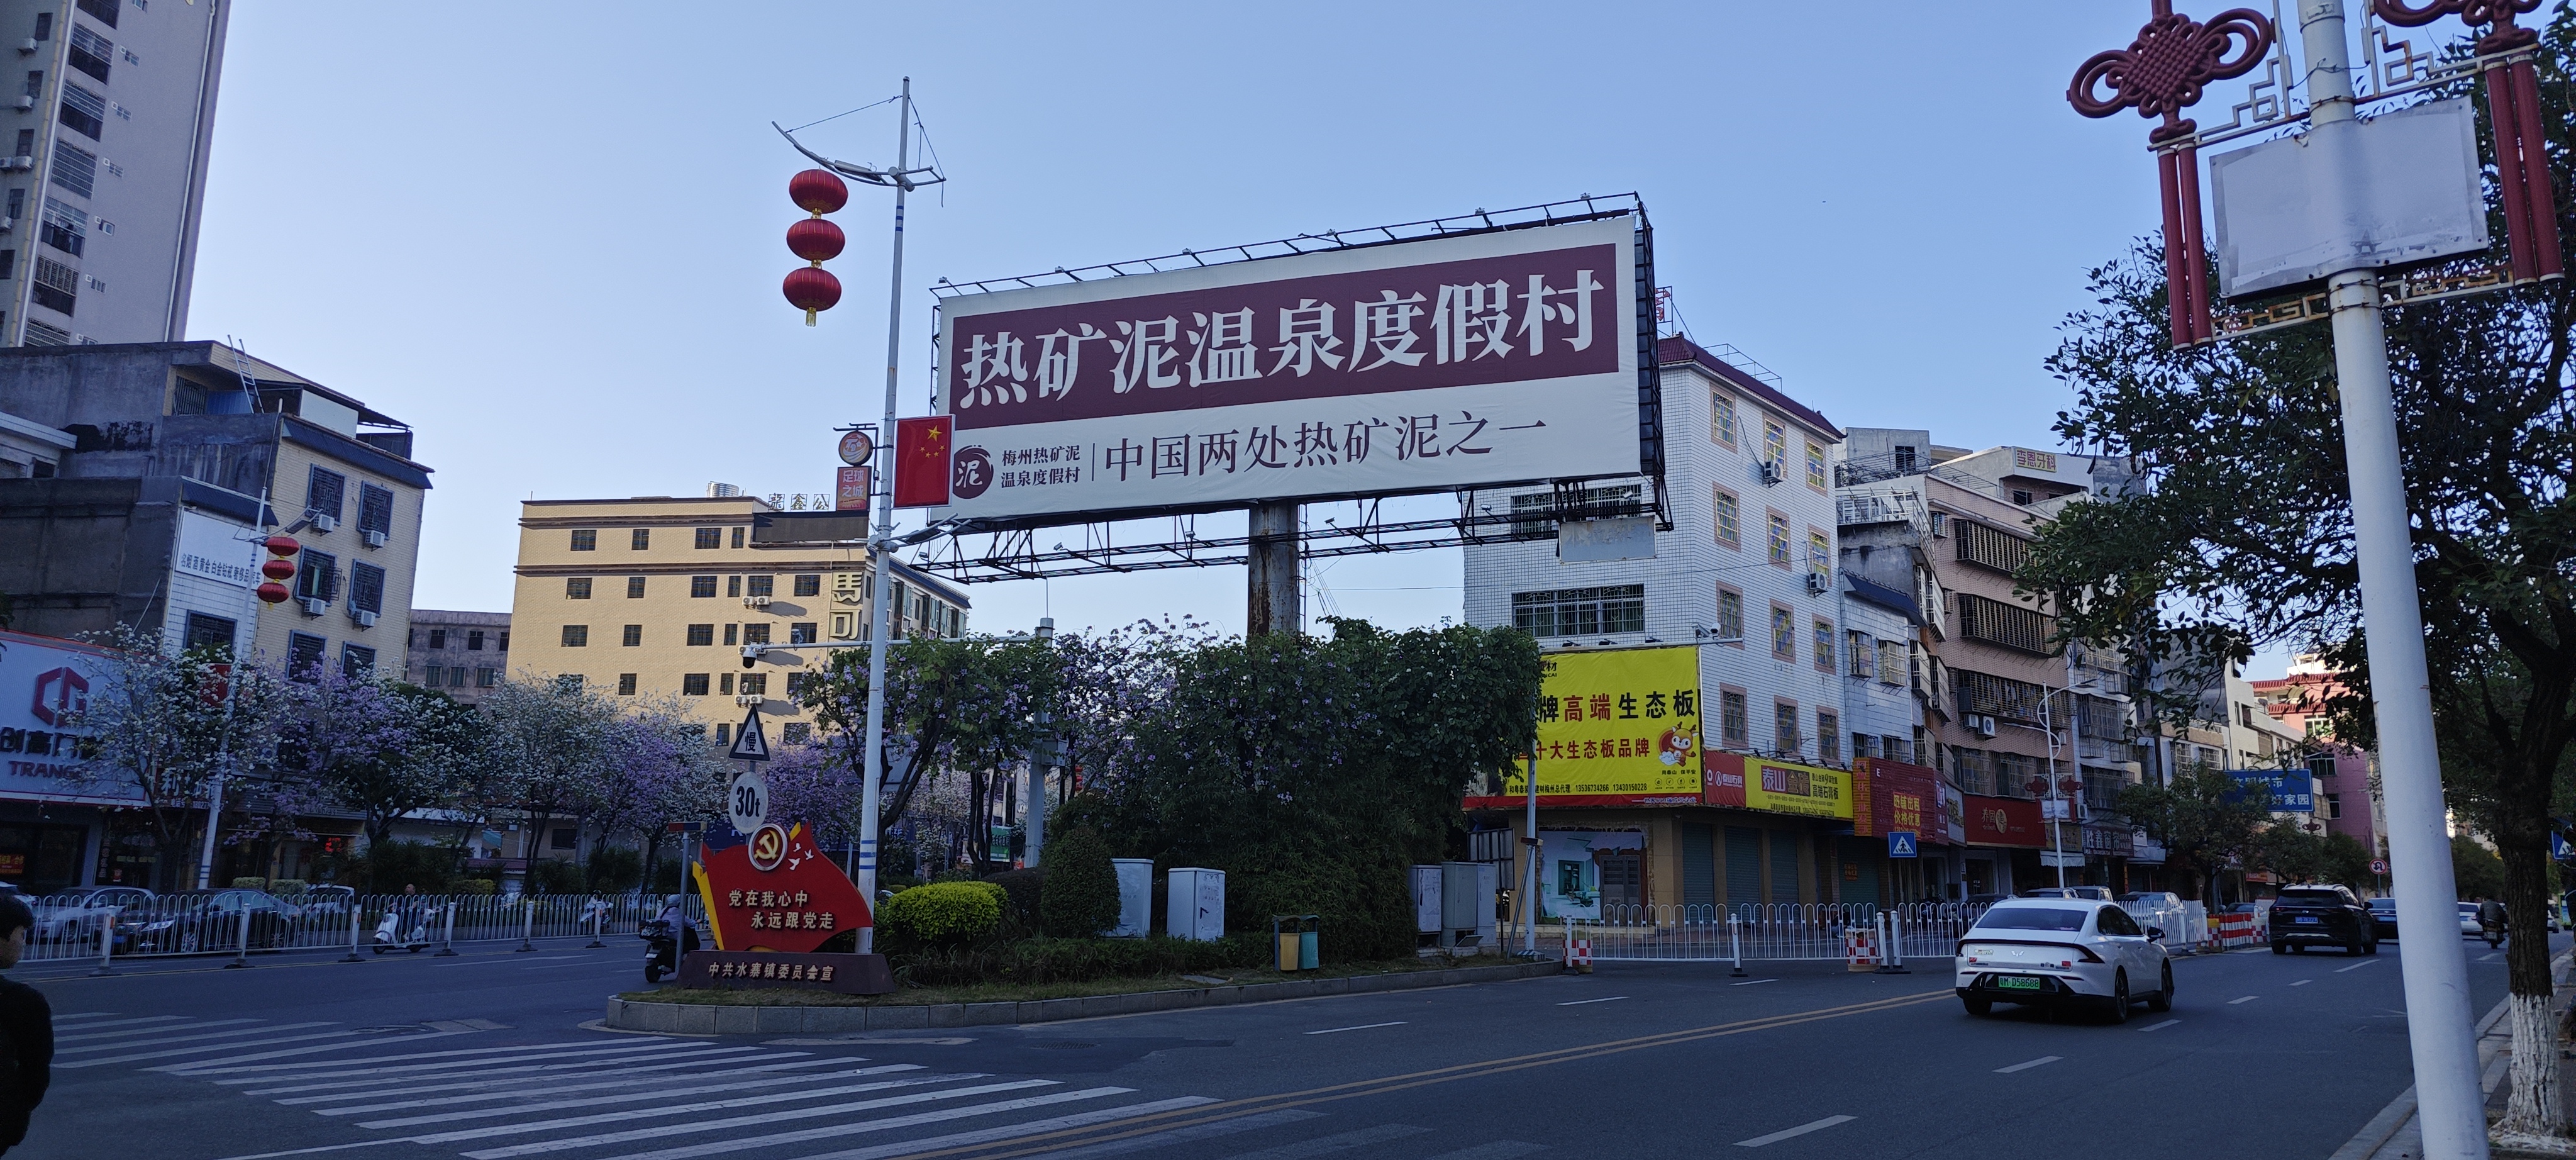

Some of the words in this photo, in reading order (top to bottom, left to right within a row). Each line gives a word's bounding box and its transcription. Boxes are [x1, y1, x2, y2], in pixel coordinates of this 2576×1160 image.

[959, 270, 1604, 410] 热矿泥温泉度假村
[1001, 445, 1081, 466] 梅州热矿泥
[1106, 410, 1546, 482] 中国两处热矿泥之一
[2017, 450, 2057, 470] 李恩牙科
[843, 470, 864, 482] 足球
[955, 461, 983, 489] 泥
[1001, 467, 1081, 488] 温泉度假村
[843, 485, 864, 498] 之城
[830, 571, 863, 640] 馬可
[744, 732, 757, 752] 慢
[1575, 784, 1609, 793] 13536734266
[1613, 783, 1648, 792] 13430150228
[1762, 767, 1810, 796] 泰山金砖
[736, 786, 760, 818] 30t
[1813, 784, 1839, 800] 高端石膏板
[1893, 795, 1921, 811] 旺铺出租
[1894, 810, 1921, 827] 价格优惠
[729, 890, 809, 907] 党在我心中
[751, 912, 834, 929] 永远跟党走
[708, 962, 834, 982] 中共水寨镇委员会宣
